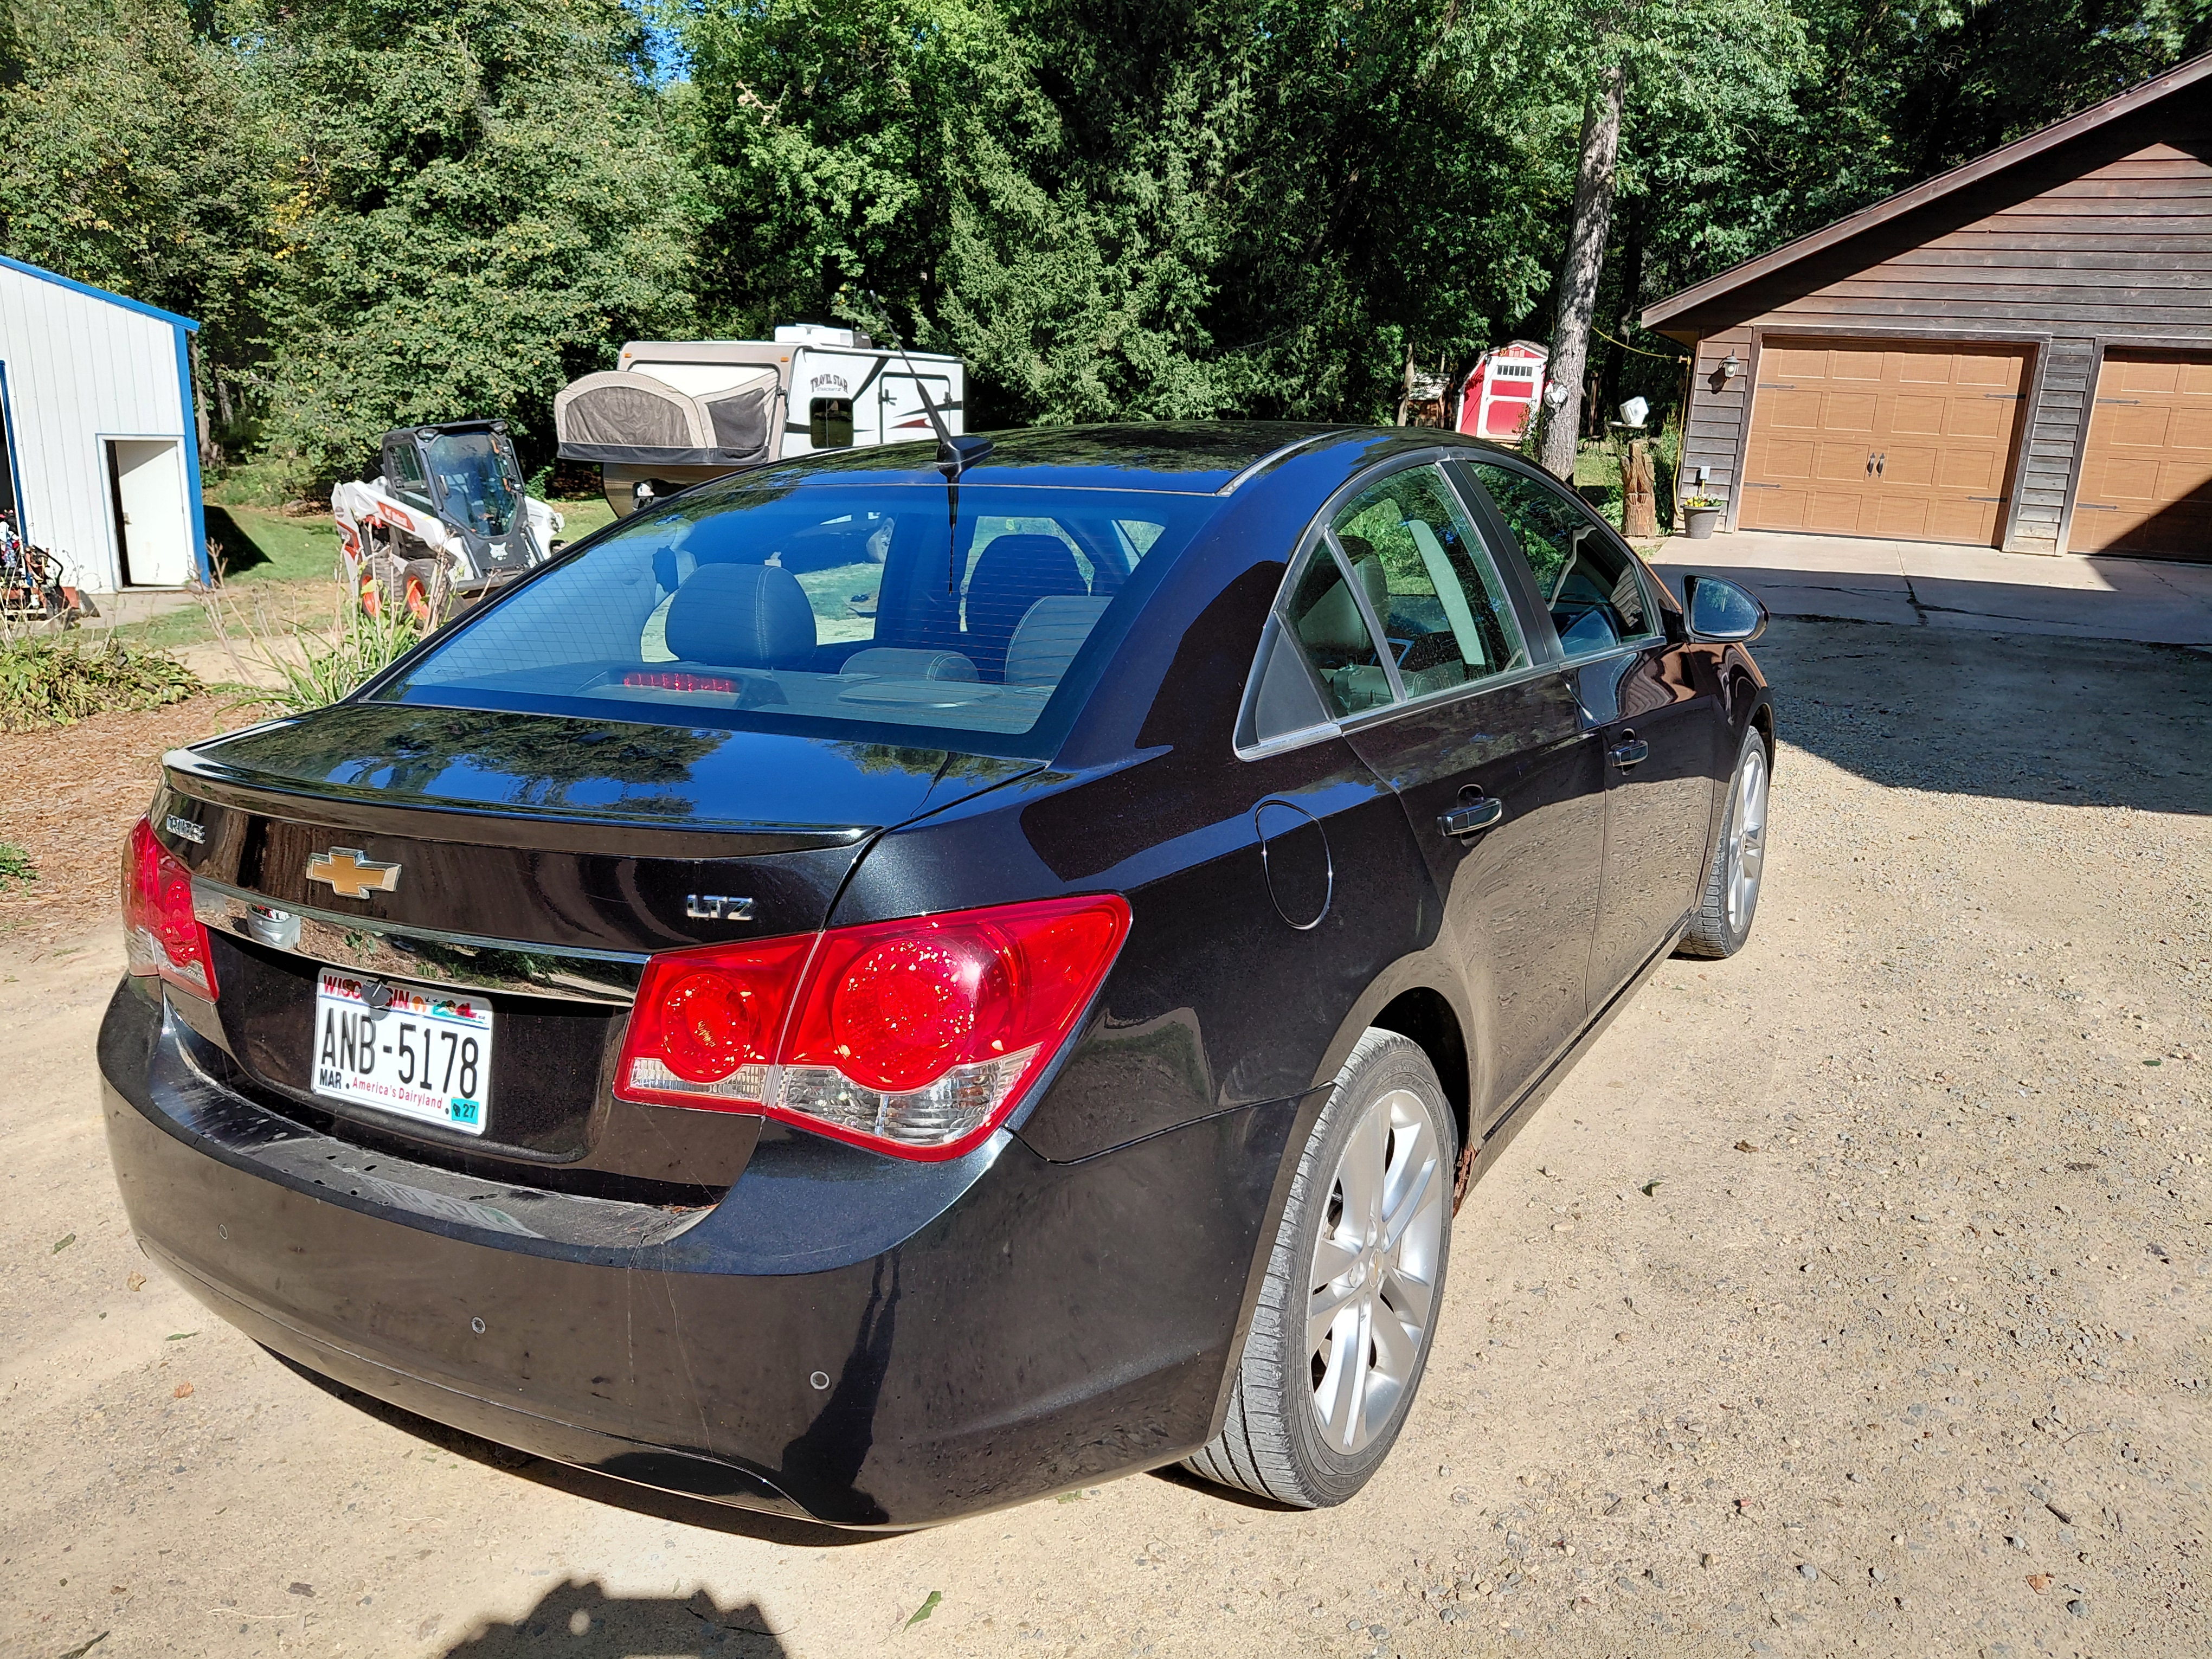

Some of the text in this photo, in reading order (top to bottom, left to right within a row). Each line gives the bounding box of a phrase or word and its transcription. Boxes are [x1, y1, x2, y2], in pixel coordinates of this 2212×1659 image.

[811, 374, 848, 394] TRAVEL STAR
[686, 894, 754, 921] LTZ
[321, 1007, 479, 1098] ANB-5178
[319, 1068, 342, 1089] MAR
[352, 1077, 442, 1109] America's Dairyland
[462, 1103, 476, 1119] 27
